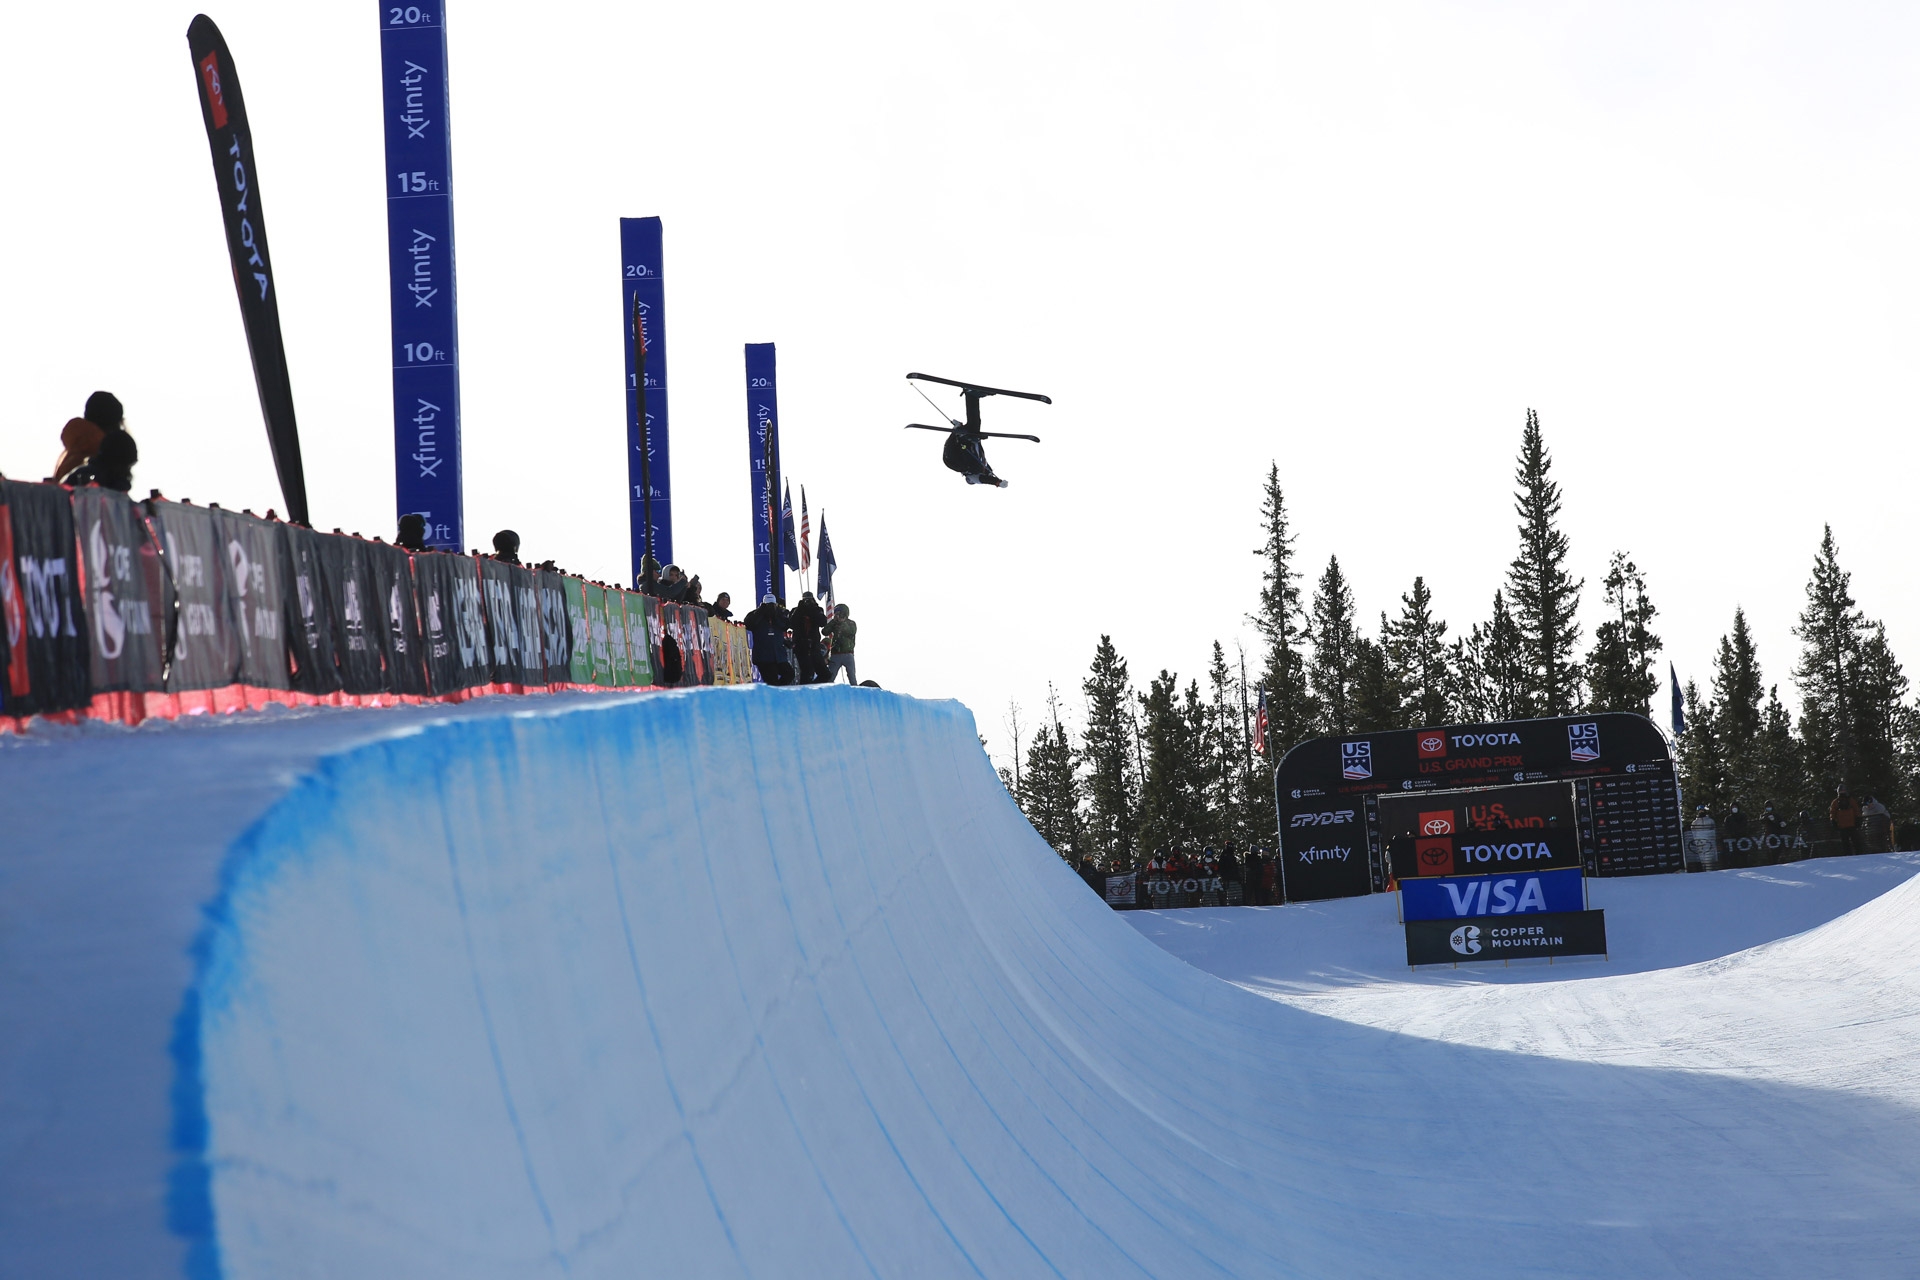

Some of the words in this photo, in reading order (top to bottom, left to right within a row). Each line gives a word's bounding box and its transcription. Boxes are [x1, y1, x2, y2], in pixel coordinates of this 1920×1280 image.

[400, 60, 430, 139] xfinity
[229, 134, 268, 302] TOYOTA
[408, 228, 438, 308] xfinity
[412, 398, 443, 478] xfinity
[1451, 732, 1521, 748] TOYOTA
[1569, 724, 1597, 738] US
[1343, 742, 1369, 756] US
[1419, 761, 1443, 774] U.S.
[1445, 757, 1492, 771] GRAND
[1494, 754, 1524, 767] PRIX
[1290, 809, 1355, 828] SPYDER
[1461, 842, 1552, 863] TOYOTA
[1723, 834, 1808, 853] TOYOTA
[1299, 845, 1352, 865] xfinity
[1143, 877, 1225, 896] TOYOTA
[1437, 877, 1547, 916] VISA
[1491, 926, 1544, 938] COPPER
[1492, 936, 1563, 948] MOUNTAIN
